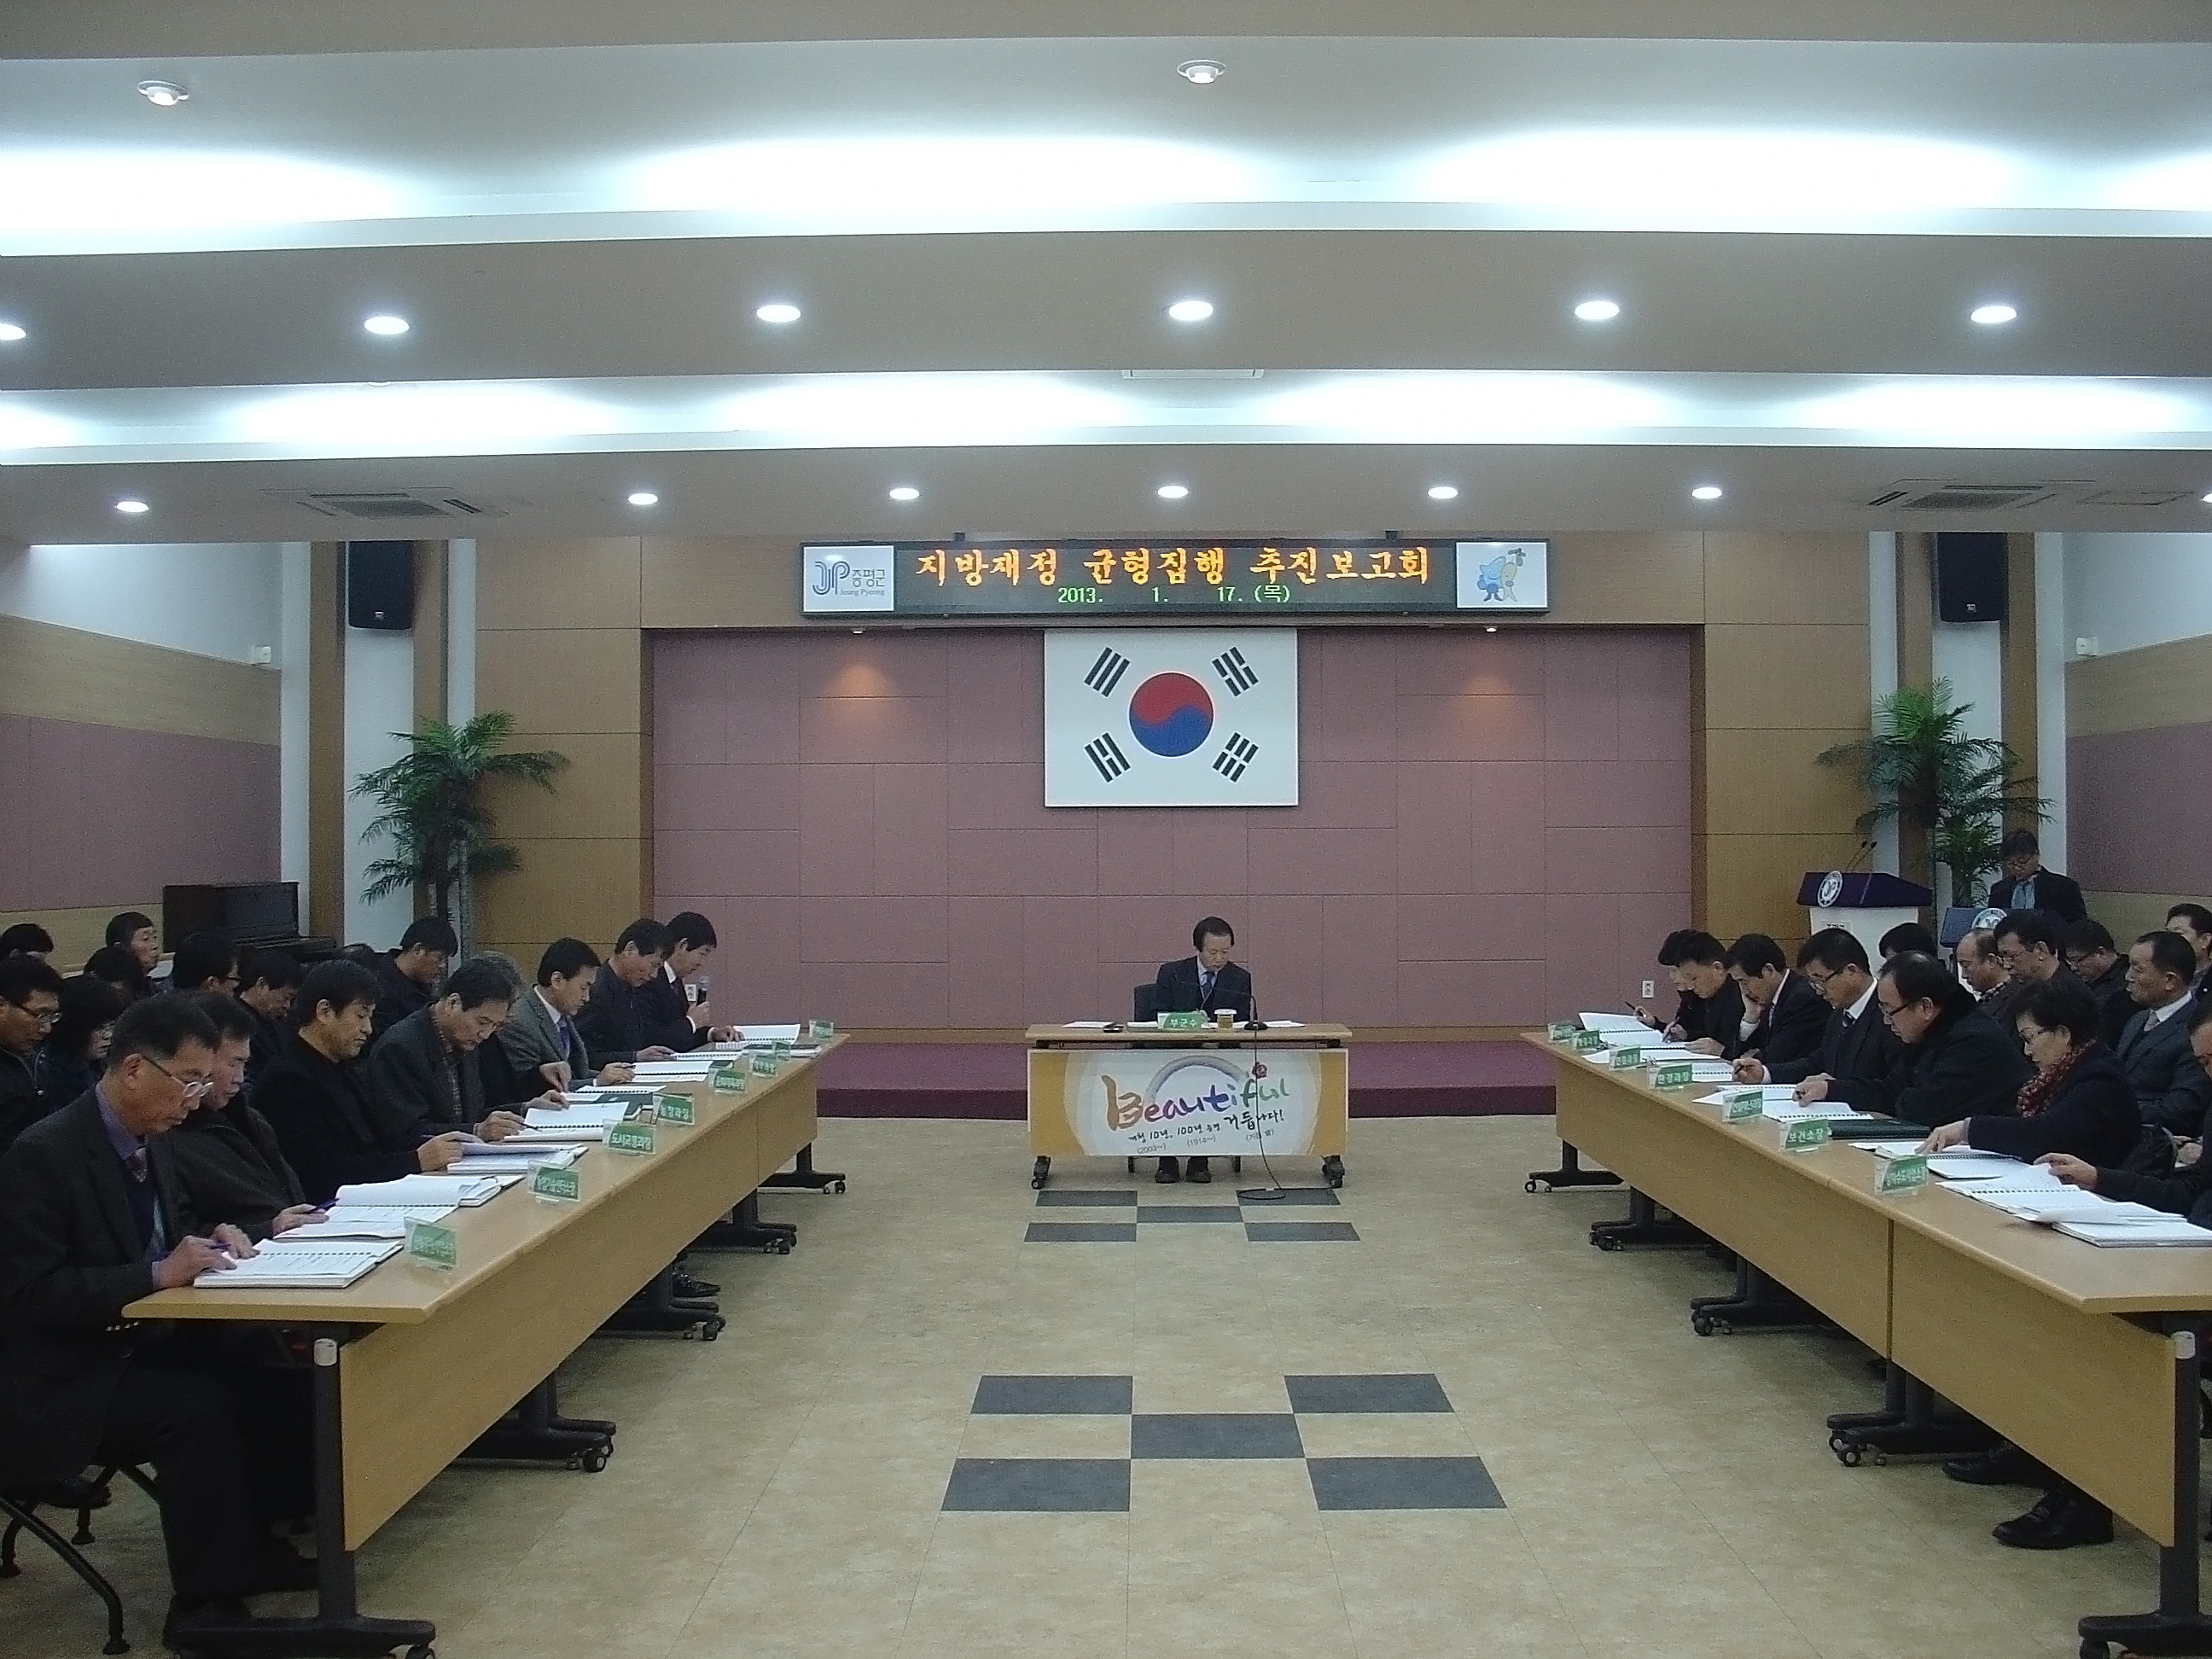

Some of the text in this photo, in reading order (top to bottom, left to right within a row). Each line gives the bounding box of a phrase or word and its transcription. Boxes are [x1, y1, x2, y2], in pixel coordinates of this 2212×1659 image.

[916, 548, 1057, 586] 지방재정
[1083, 547, 1225, 585] 균형집행
[852, 569, 886, 587] 증평군
[1057, 585, 1290, 603] 2013. 1. 17. (목)
[1170, 1018, 1197, 1027] 부군수
[1101, 1074, 1289, 1132] Beautiful
[1223, 1109, 1284, 1131] 거듭나다!
[1789, 1127, 1824, 1143] 보건소장
